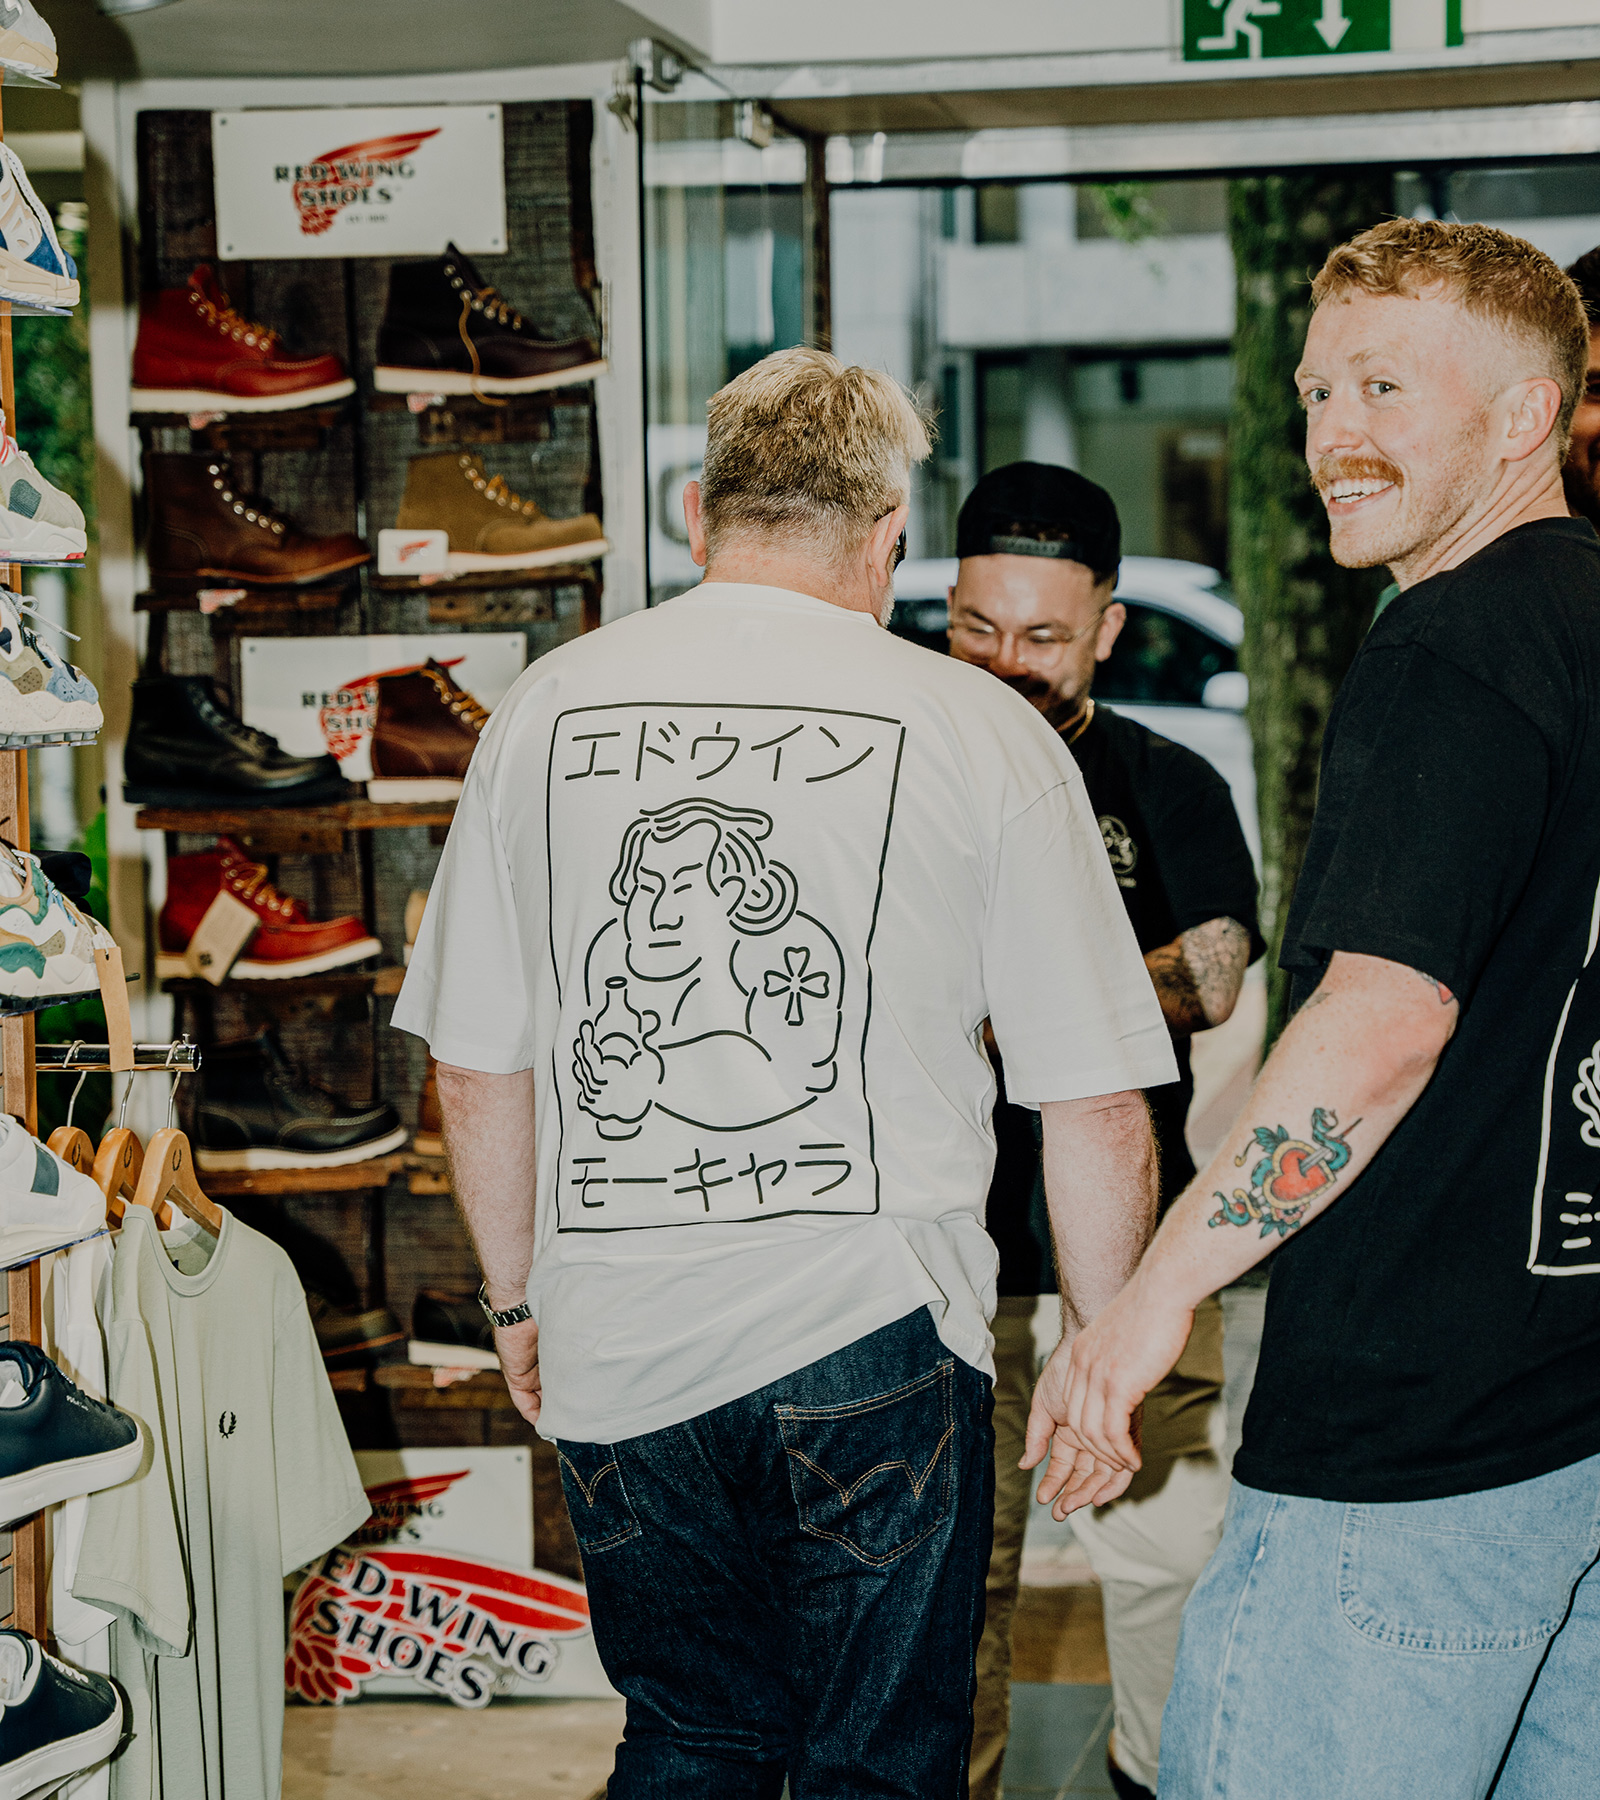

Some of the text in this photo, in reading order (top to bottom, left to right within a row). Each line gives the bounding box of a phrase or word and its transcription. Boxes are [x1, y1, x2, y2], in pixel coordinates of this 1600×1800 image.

[274, 160, 415, 183] RED WING
[301, 186, 393, 207] SHOES
[302, 691, 353, 708] RED
[349, 1526, 422, 1544] HOES
[306, 1548, 548, 1676] ED WING
[311, 1599, 488, 1701] SHOES
